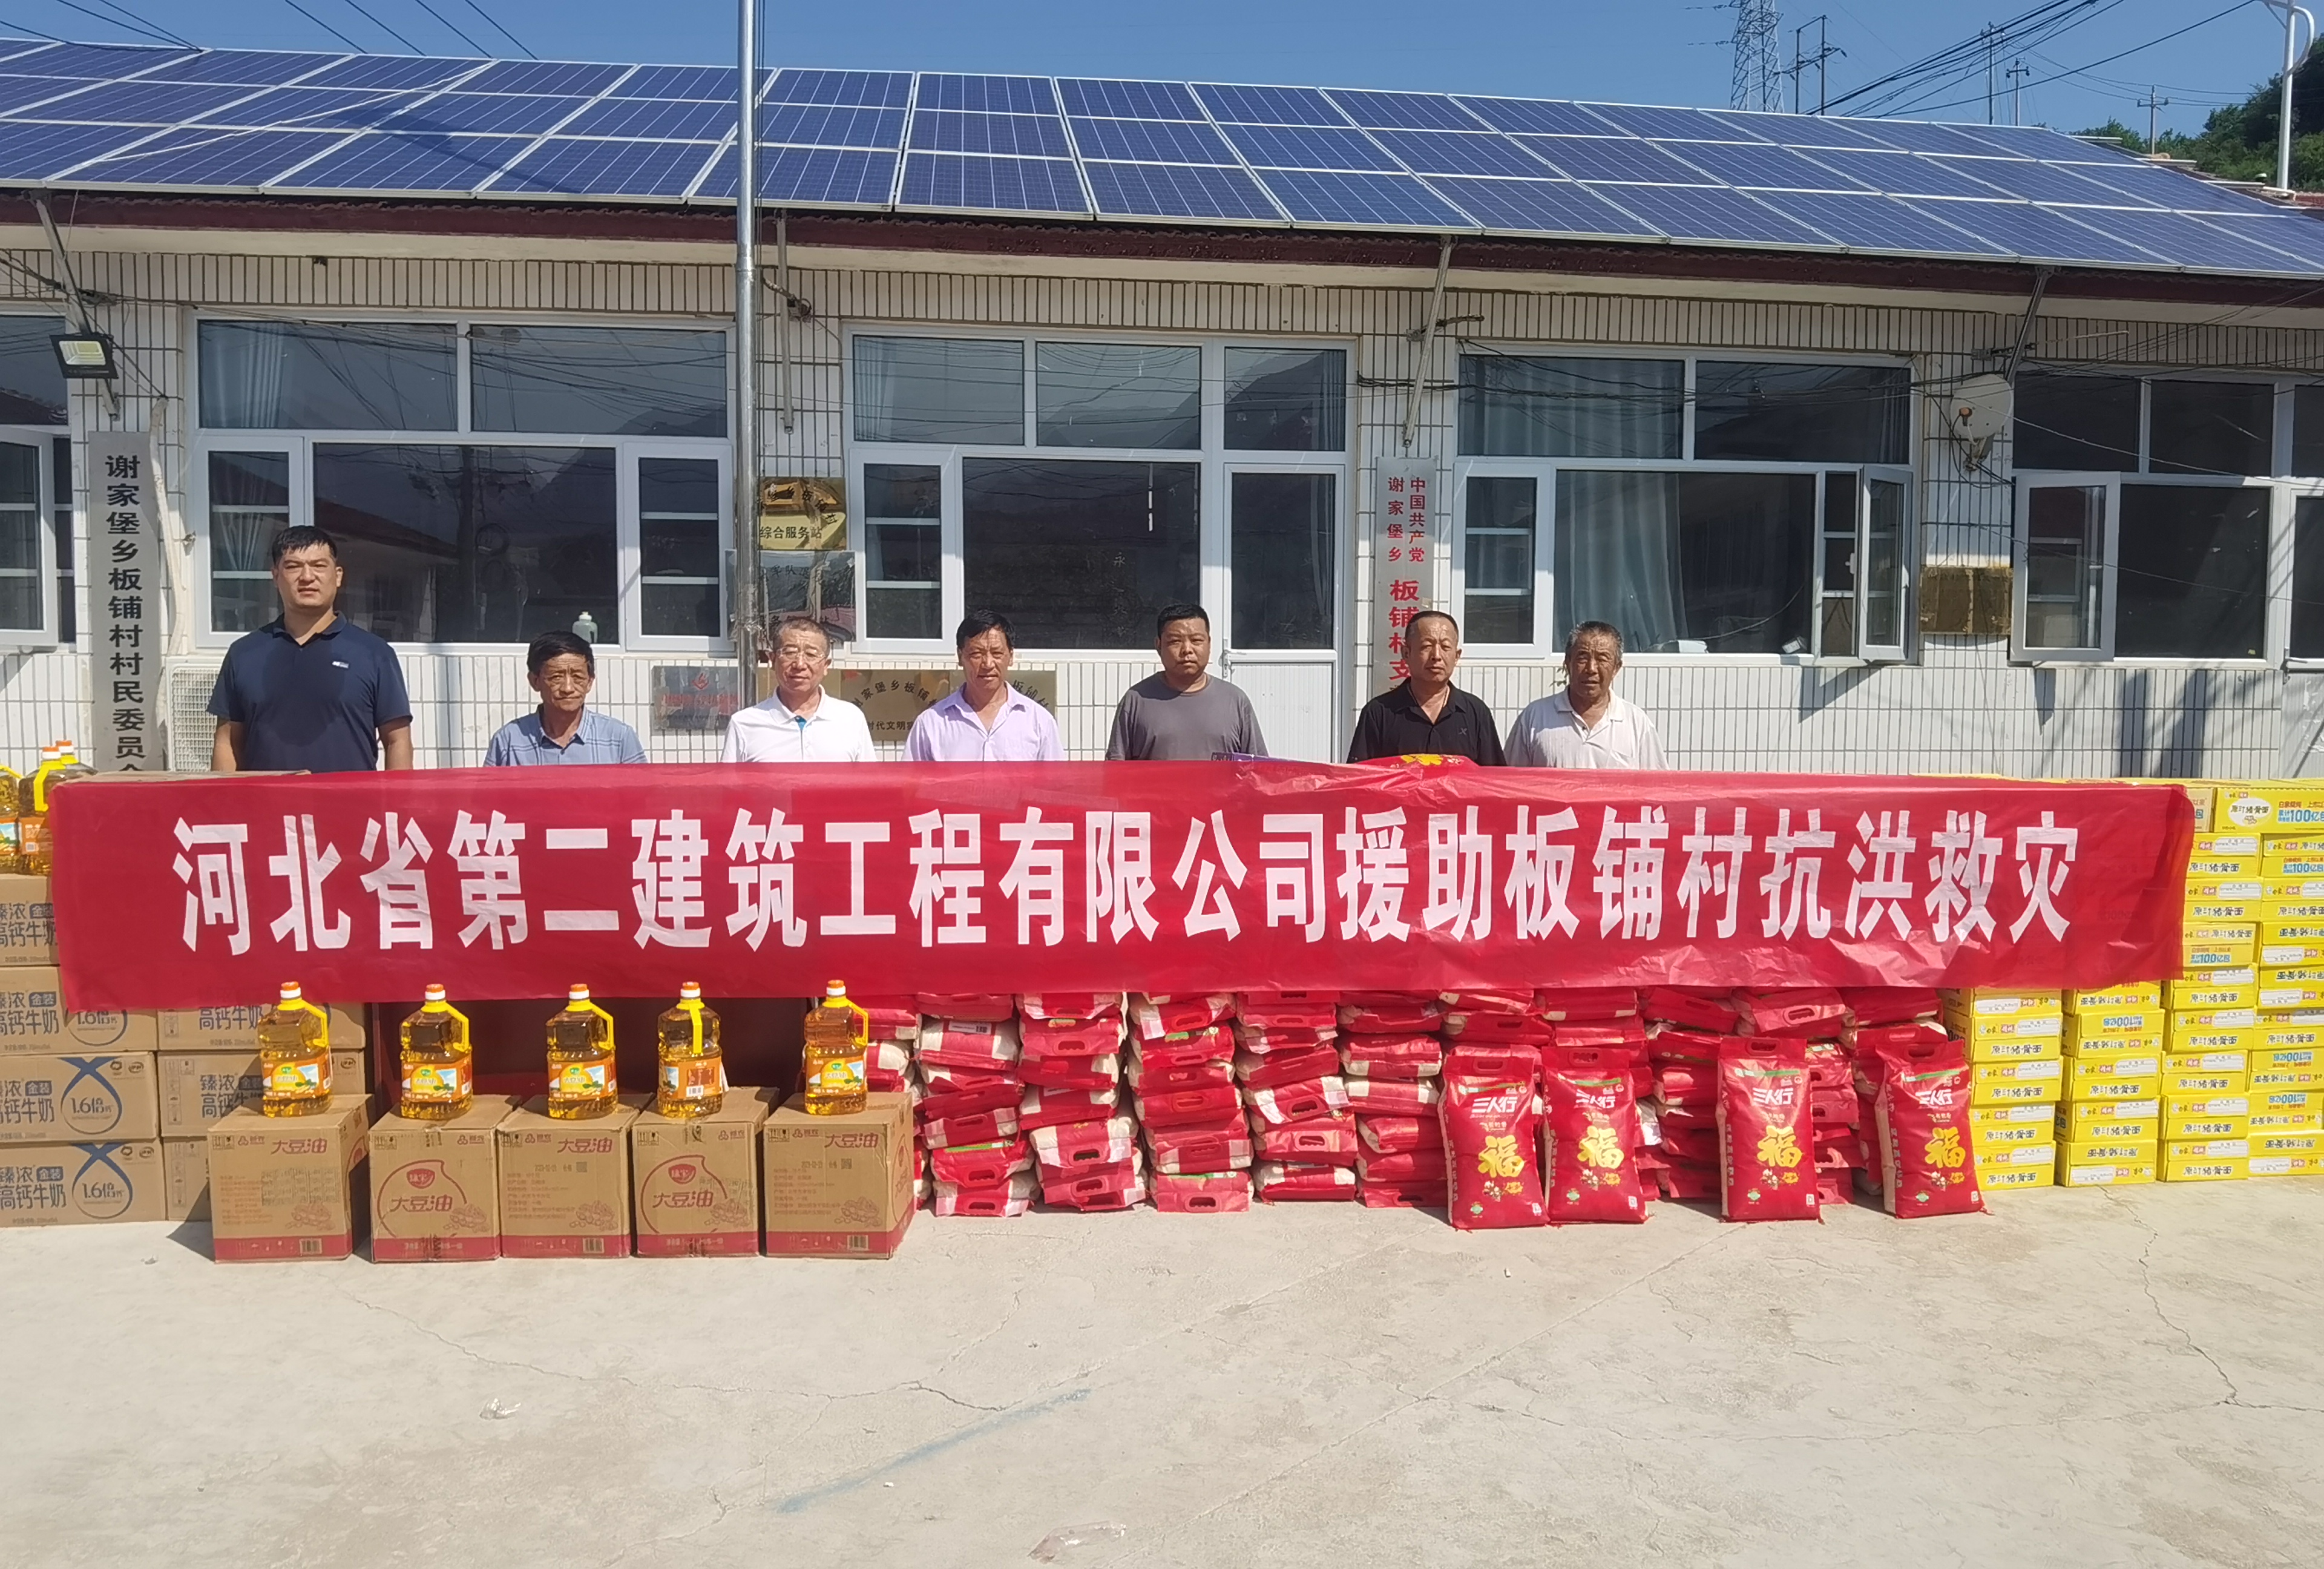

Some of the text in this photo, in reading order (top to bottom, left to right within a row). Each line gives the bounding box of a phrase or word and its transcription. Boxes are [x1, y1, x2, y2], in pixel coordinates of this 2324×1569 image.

[1387, 476, 1405, 563] 谢家堡乡
[1409, 477, 1426, 563] 中国共产党
[759, 526, 822, 539] 综合服务站
[1388, 579, 1420, 691] 板铺村支
[2189, 863, 2240, 873] 原汁猪骨面
[172, 806, 2078, 956] 河北省第二建筑工程有限公司援助板铺村抗洪救灾
[2193, 907, 2244, 916] 原汁猪骨面
[2190, 993, 2238, 1003] 原汁猪骨面
[2189, 1036, 2238, 1046] 原汁猪骨面
[2267, 1034, 2315, 1044] 原汁猪骨面
[1991, 1044, 2043, 1054] 原汁猪骨面
[2090, 1085, 2140, 1094] 原汁猪骨面
[2179, 1079, 2229, 1088] 原汁猪骨面
[1753, 1087, 1793, 1105] 三人行
[1915, 1089, 1953, 1105] 三人行
[1992, 1087, 2043, 1097] 原汁猪骨面
[0, 1098, 54, 1124] 钙牛奶
[1471, 1097, 1518, 1113] 三人行
[1984, 1130, 2035, 1140] 原汁猪骨面
[2092, 1126, 2141, 1136] 原汁猪骨面
[2183, 1123, 2232, 1133] 原汁猪骨面
[270, 1137, 327, 1155] 大豆油
[557, 1137, 612, 1154] 大豆油
[824, 1133, 879, 1148] 大豆油
[1577, 1125, 1624, 1169] 福
[1757, 1125, 1802, 1168] 福
[1925, 1127, 1966, 1168] 福
[1478, 1135, 1526, 1178] 福
[1987, 1173, 2037, 1183] 原汁猪骨面
[2183, 1166, 2232, 1176] 原汁猪骨面
[0, 1183, 67, 1209] 高钙牛奶
[390, 1194, 453, 1212] 大豆油
[652, 1189, 714, 1208] 大豆油
